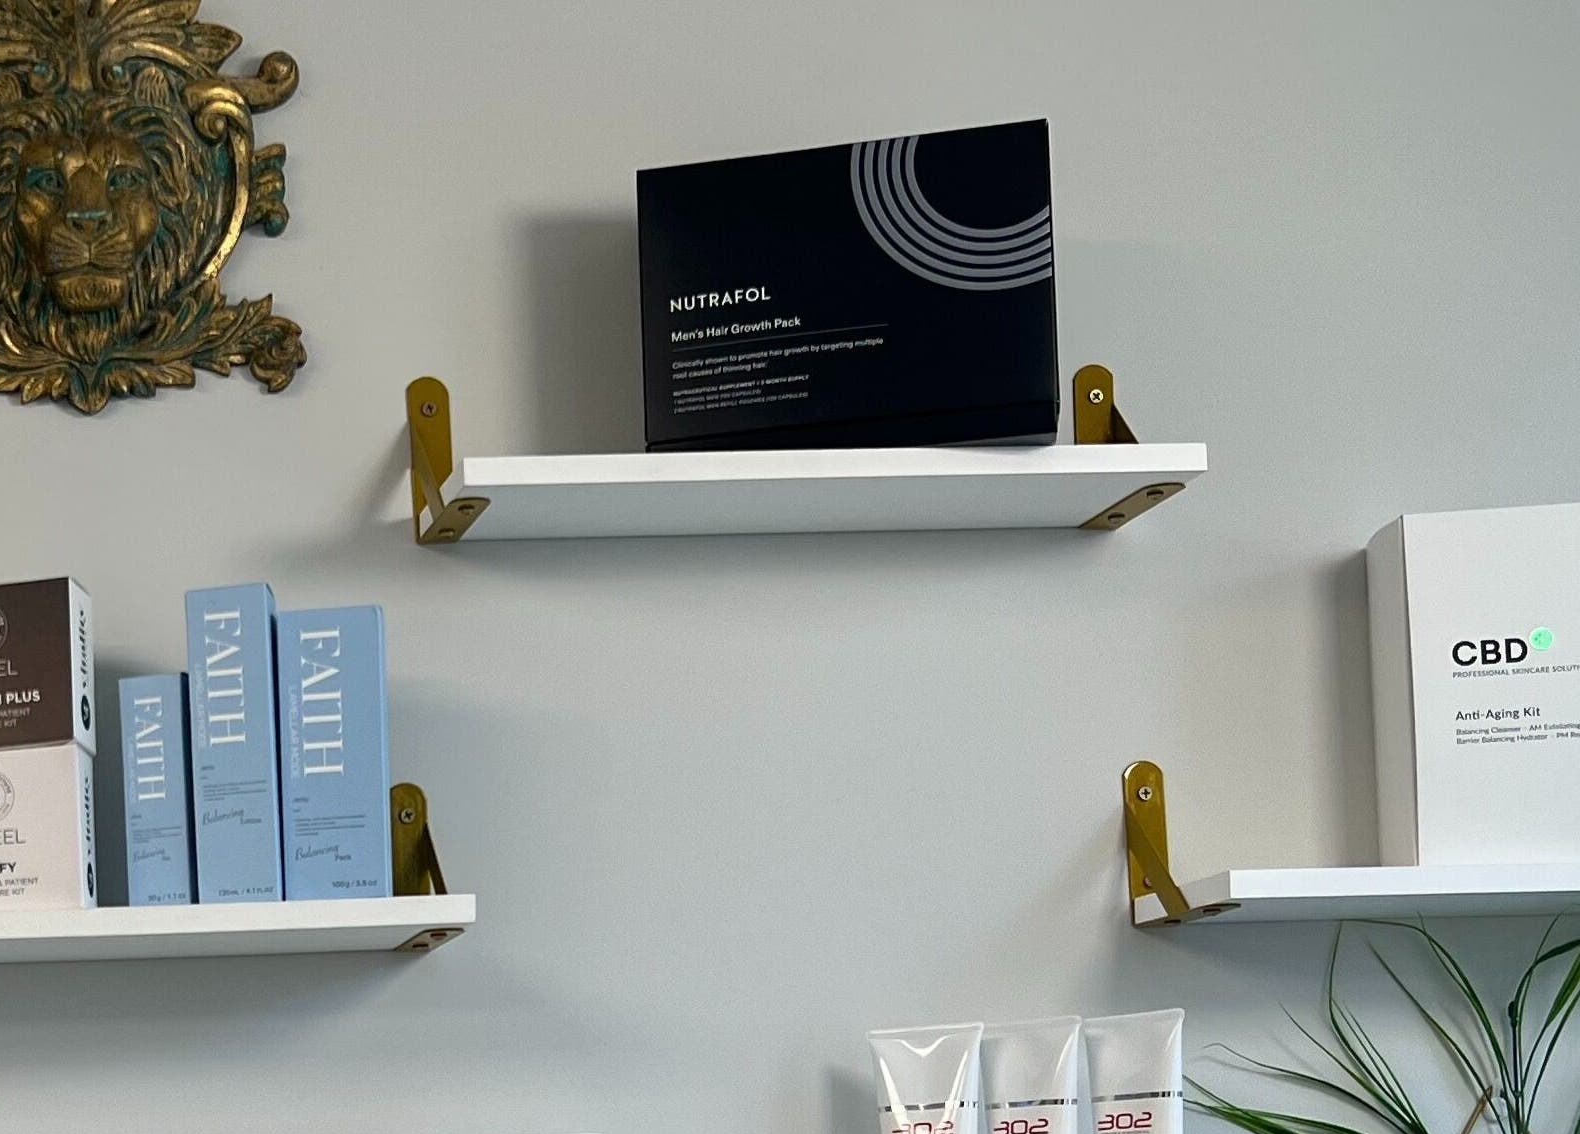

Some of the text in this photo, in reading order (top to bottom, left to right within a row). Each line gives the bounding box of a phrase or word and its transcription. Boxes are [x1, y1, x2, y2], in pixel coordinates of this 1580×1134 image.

[669, 285, 772, 313] NUTRAFOL
[671, 315, 801, 342] Men's Hair Growth Pack
[820, 341, 854, 352] targeting
[1451, 638, 1528, 667] CBD
[203, 607, 247, 747] FAITH
[1452, 668, 1510, 679] PROFESSIONAL
[1511, 666, 1551, 676] SKINCARE
[6, 689, 41, 705] PLUS
[299, 624, 345, 778] FAITH
[1455, 705, 1542, 721] Anti-Aging Kit
[1456, 727, 1489, 737] Balancing
[1481, 735, 1516, 744] Balancing
[133, 695, 166, 801] FAITH
[4, 876, 39, 887] PATIENT
[11, 886, 26, 897] KIT
[1097, 1112, 1152, 1132] 302
